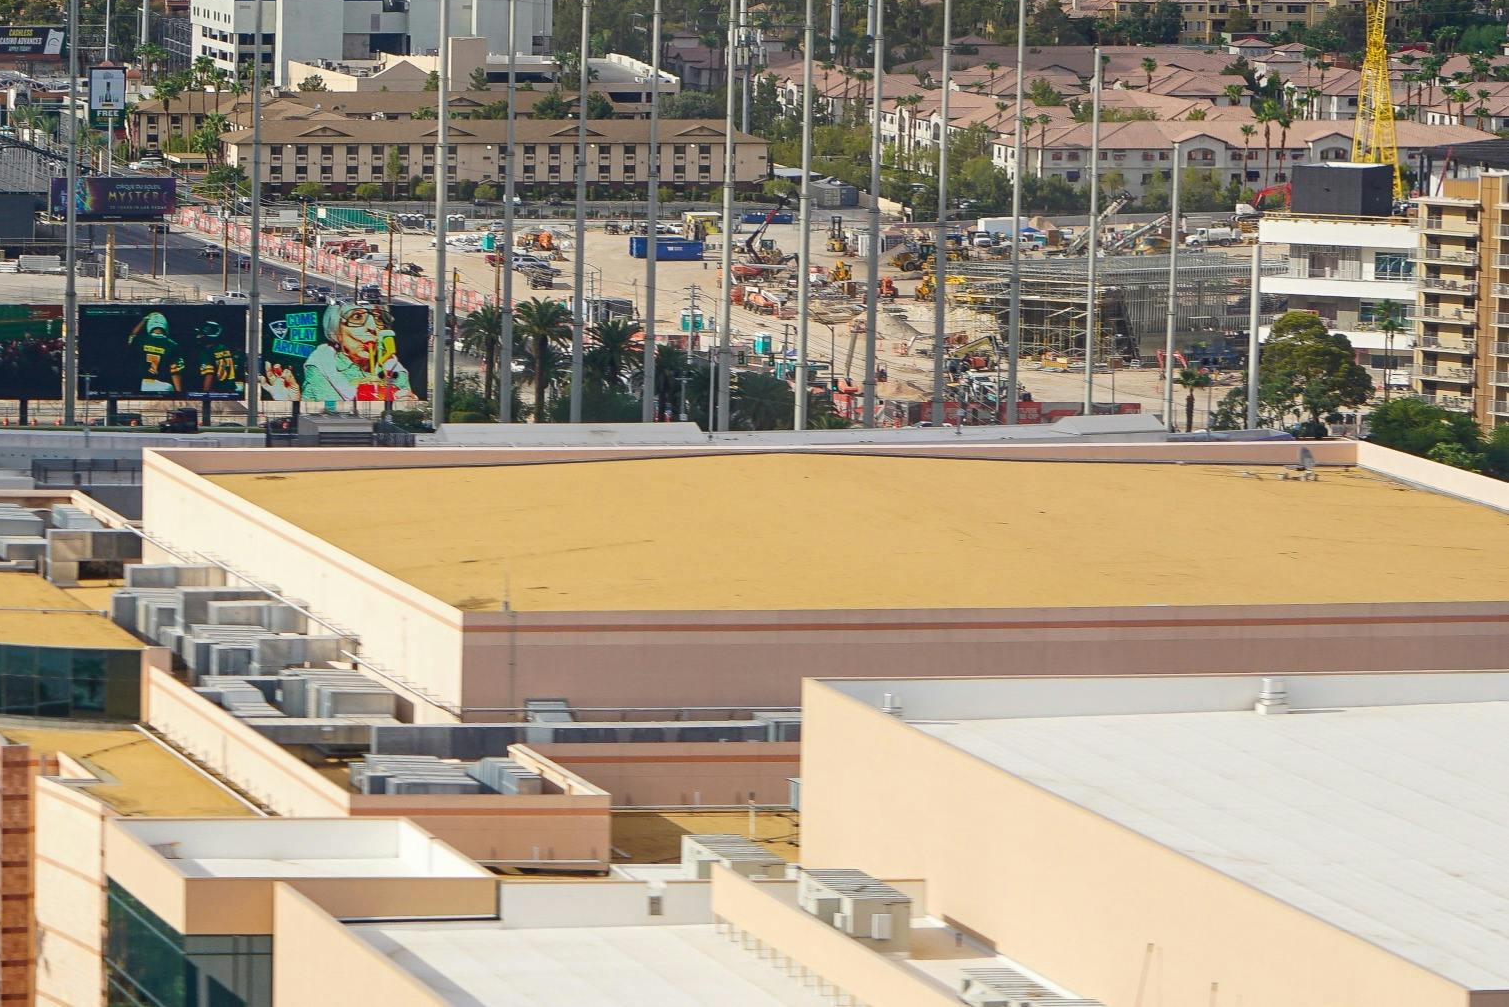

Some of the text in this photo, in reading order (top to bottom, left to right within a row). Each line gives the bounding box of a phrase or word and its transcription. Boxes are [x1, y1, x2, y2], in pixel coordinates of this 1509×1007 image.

[8, 28, 34, 37] CASHLESS
[0, 37, 43, 45] CASINO ADVANCES
[290, 313, 317, 325] COME
[292, 328, 315, 340] PLAY
